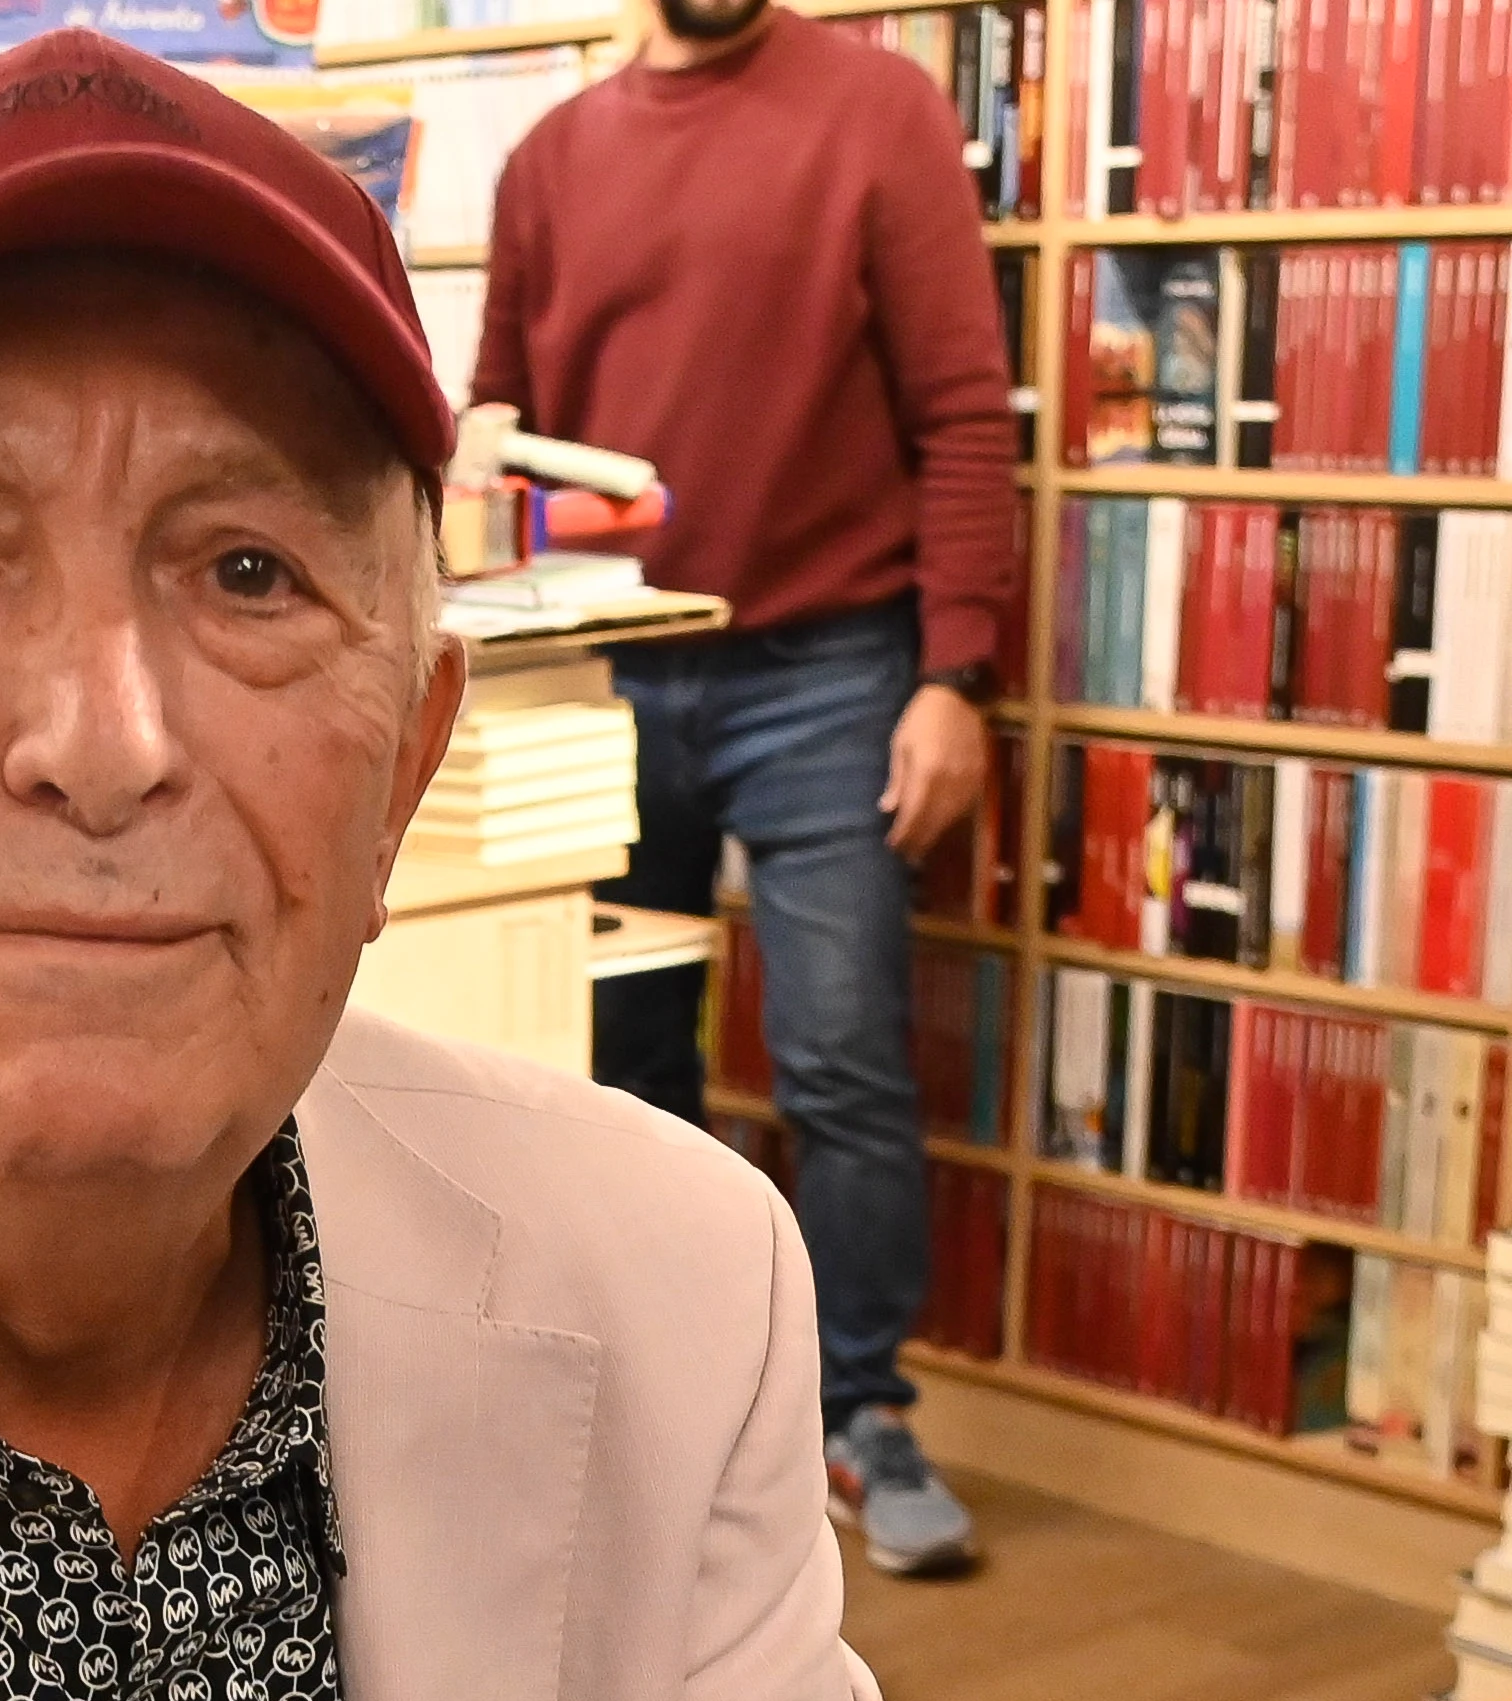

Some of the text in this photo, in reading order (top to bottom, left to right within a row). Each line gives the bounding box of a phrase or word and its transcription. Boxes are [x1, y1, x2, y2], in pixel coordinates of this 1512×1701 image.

[245, 1503, 276, 1529] MK
[76, 1525, 108, 1541] MK
[204, 1521, 235, 1547] MK
[60, 1559, 90, 1574] MK
[40, 1605, 77, 1633] MK
[97, 1597, 129, 1618] MK
[80, 1652, 115, 1679] MK
[278, 1643, 310, 1671] MK
[171, 1678, 207, 1701] MK
